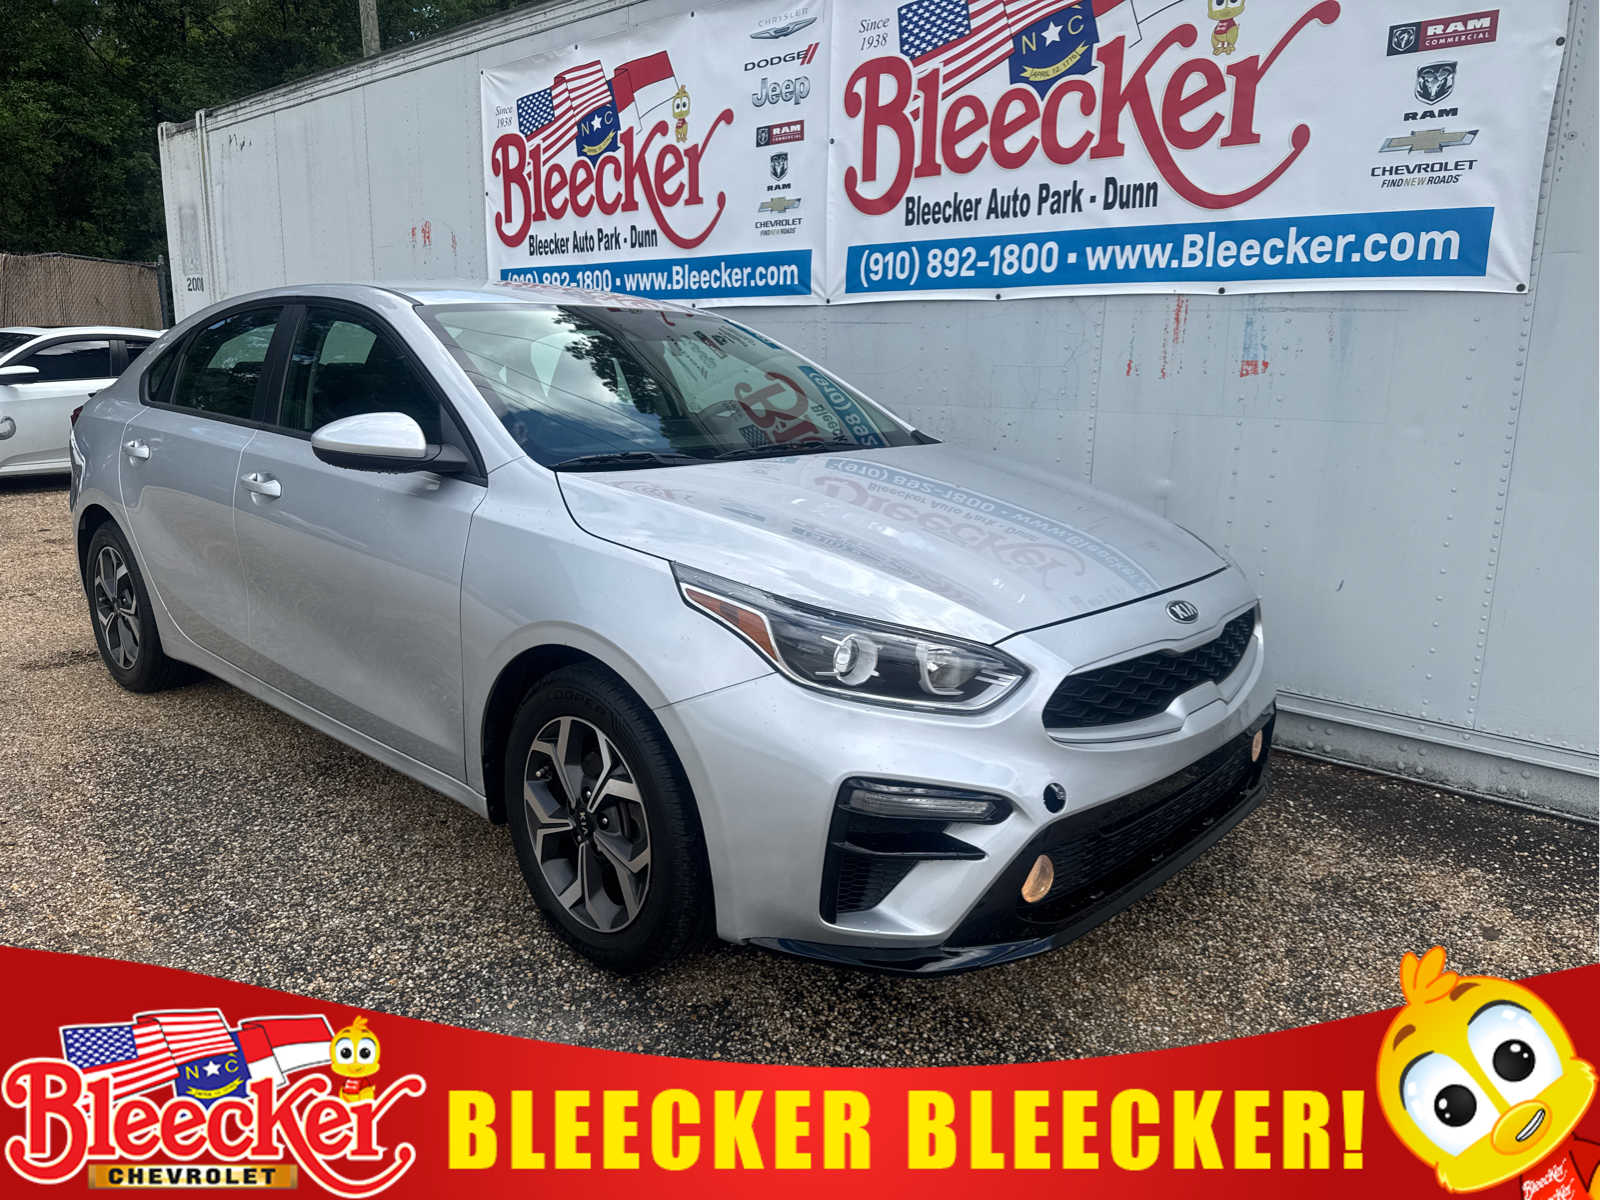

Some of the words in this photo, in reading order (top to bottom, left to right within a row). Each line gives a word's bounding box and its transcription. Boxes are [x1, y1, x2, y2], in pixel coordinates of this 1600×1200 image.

[858, 15, 890, 33] Since
[1427, 17, 1491, 36] RAM
[860, 33, 889, 50] 1938
[1425, 31, 1490, 46] COMMERCIAL
[744, 49, 809, 72] DODGE
[752, 76, 811, 107] Jeep
[495, 105, 513, 116] Since
[844, 0, 1341, 216] Bleecker
[1403, 107, 1459, 121] RAM
[496, 117, 512, 128] 1938
[772, 124, 801, 136] RAM
[1370, 159, 1479, 177] CHEVROLET
[491, 108, 734, 250] Bleecker
[767, 183, 792, 191] RAM
[904, 192, 982, 227] Bleecker
[985, 187, 1031, 220] Auto
[1037, 180, 1085, 216] Park
[1102, 176, 1159, 211] Dunn
[755, 218, 803, 229] CHEVROLET
[528, 235, 569, 257] Bleecker
[572, 232, 595, 252] Auto
[597, 227, 621, 251] Park
[630, 225, 658, 249] Dunn
[859, 246, 920, 288] (910)
[926, 241, 1059, 277] 892-1800
[1085, 226, 1460, 271] www.Bleecker.com
[624, 261, 799, 292] www.Bleecker.com
